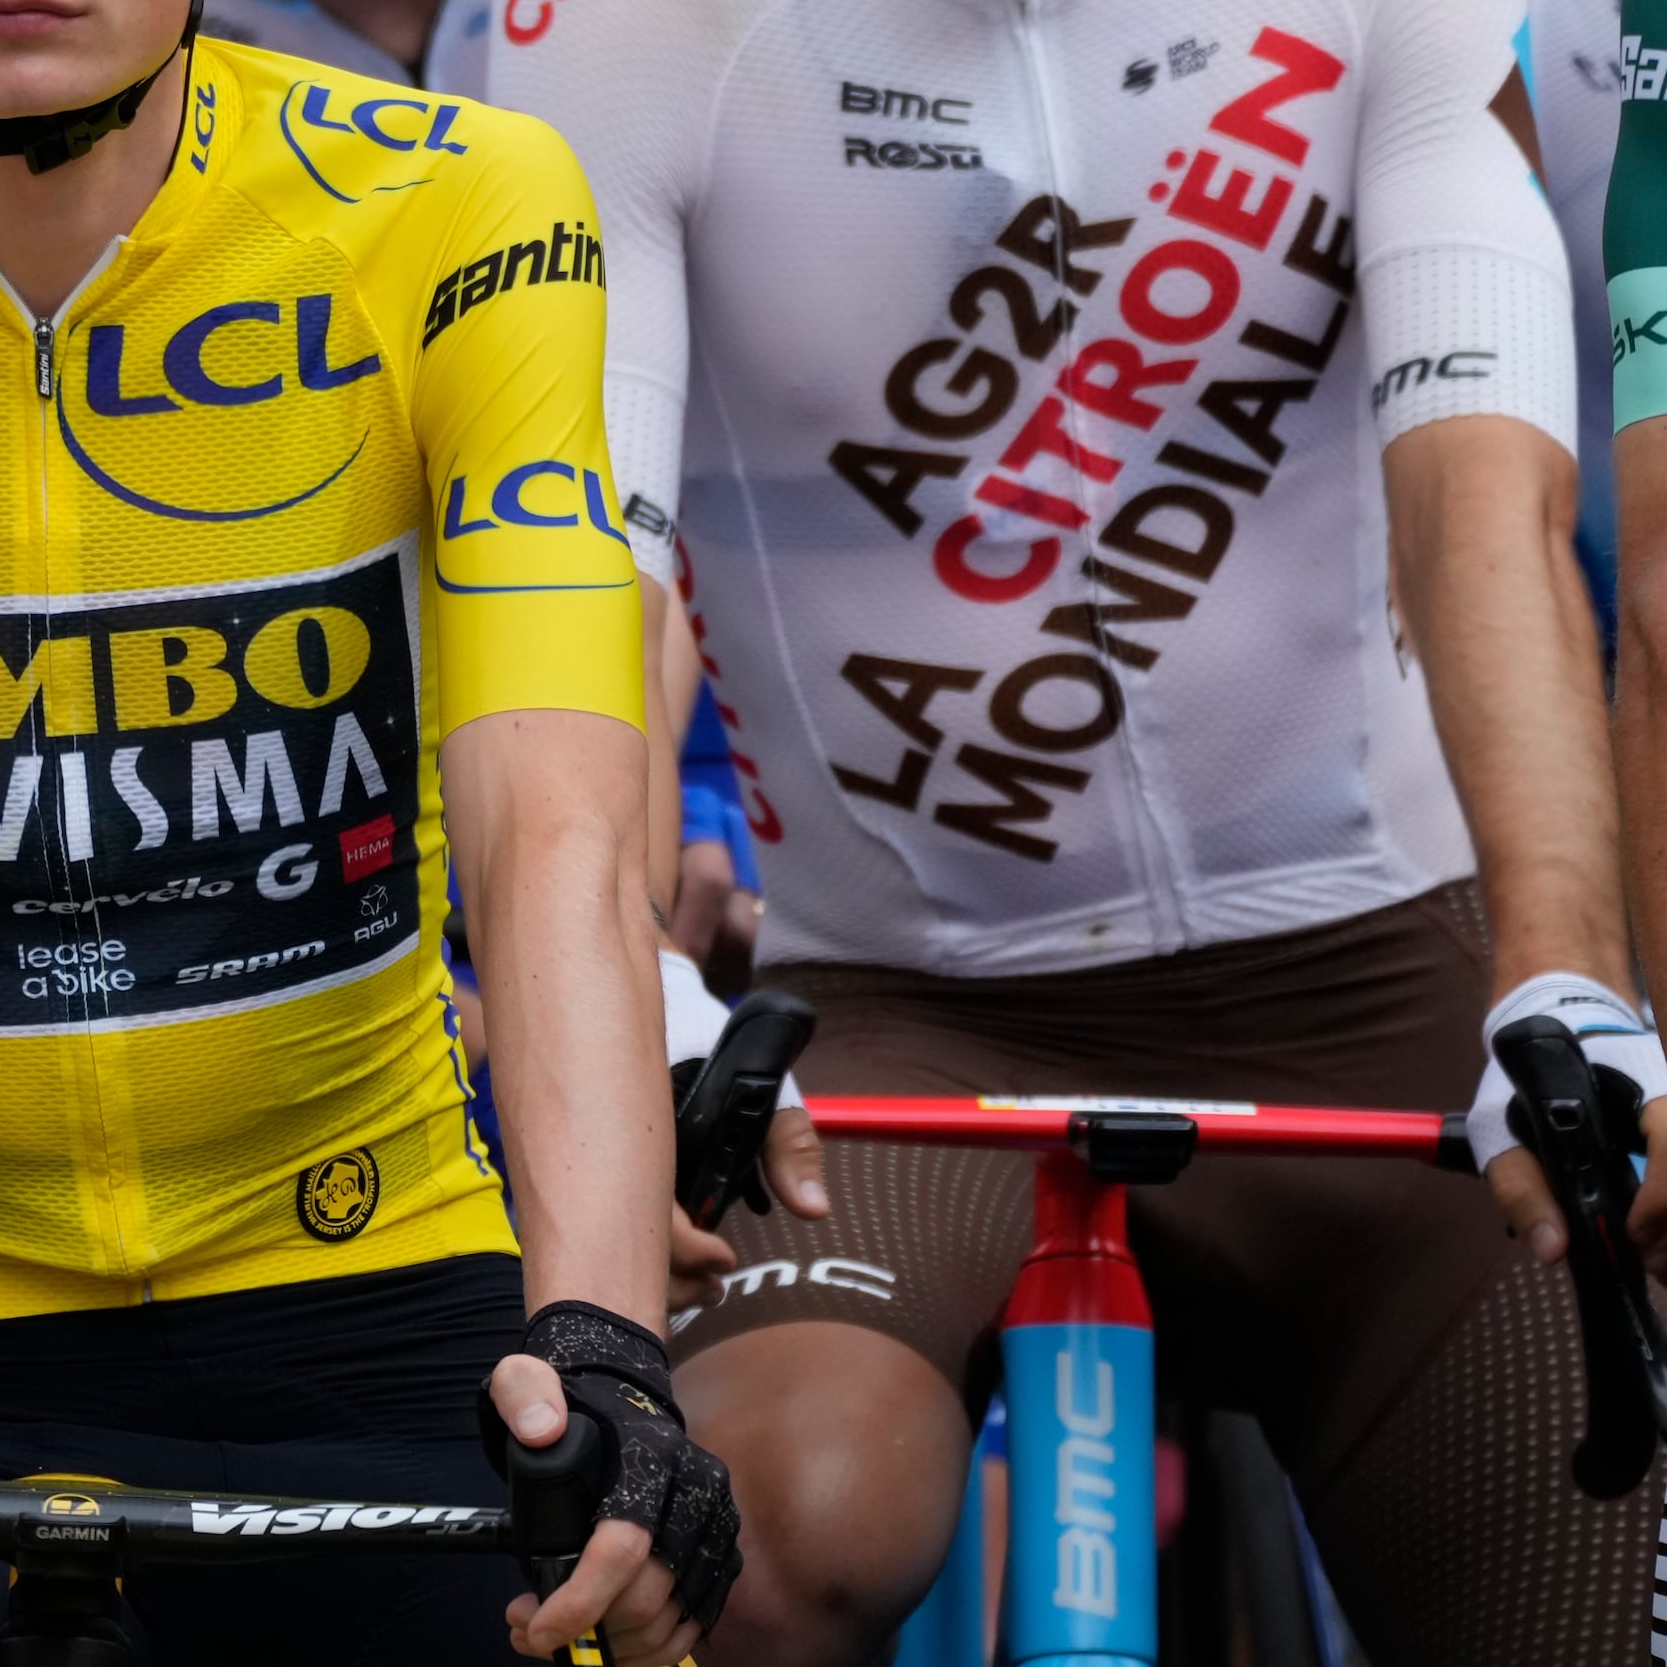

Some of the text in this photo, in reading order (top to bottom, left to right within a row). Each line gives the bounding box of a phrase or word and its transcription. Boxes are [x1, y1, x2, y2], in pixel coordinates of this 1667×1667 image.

[191, 82, 216, 175] LCL
[302, 84, 469, 156] LCL
[841, 81, 973, 125] BMC
[932, 26, 1347, 605] CITROËN
[86, 293, 382, 419] LCL
[828, 193, 1138, 539] AG2R
[443, 460, 633, 553] LCL
[830, 653, 985, 814] LA
[932, 194, 1359, 864] MONDIALE
[346, 836, 392, 865] HEMA
[18, 940, 127, 971] lease
[175, 938, 328, 987] SRAM
[354, 910, 400, 944] AGU
[668, 1257, 897, 1335] MC
[1053, 1351, 1117, 1619] BMC
[35, 1525, 110, 1542] GARMIN
